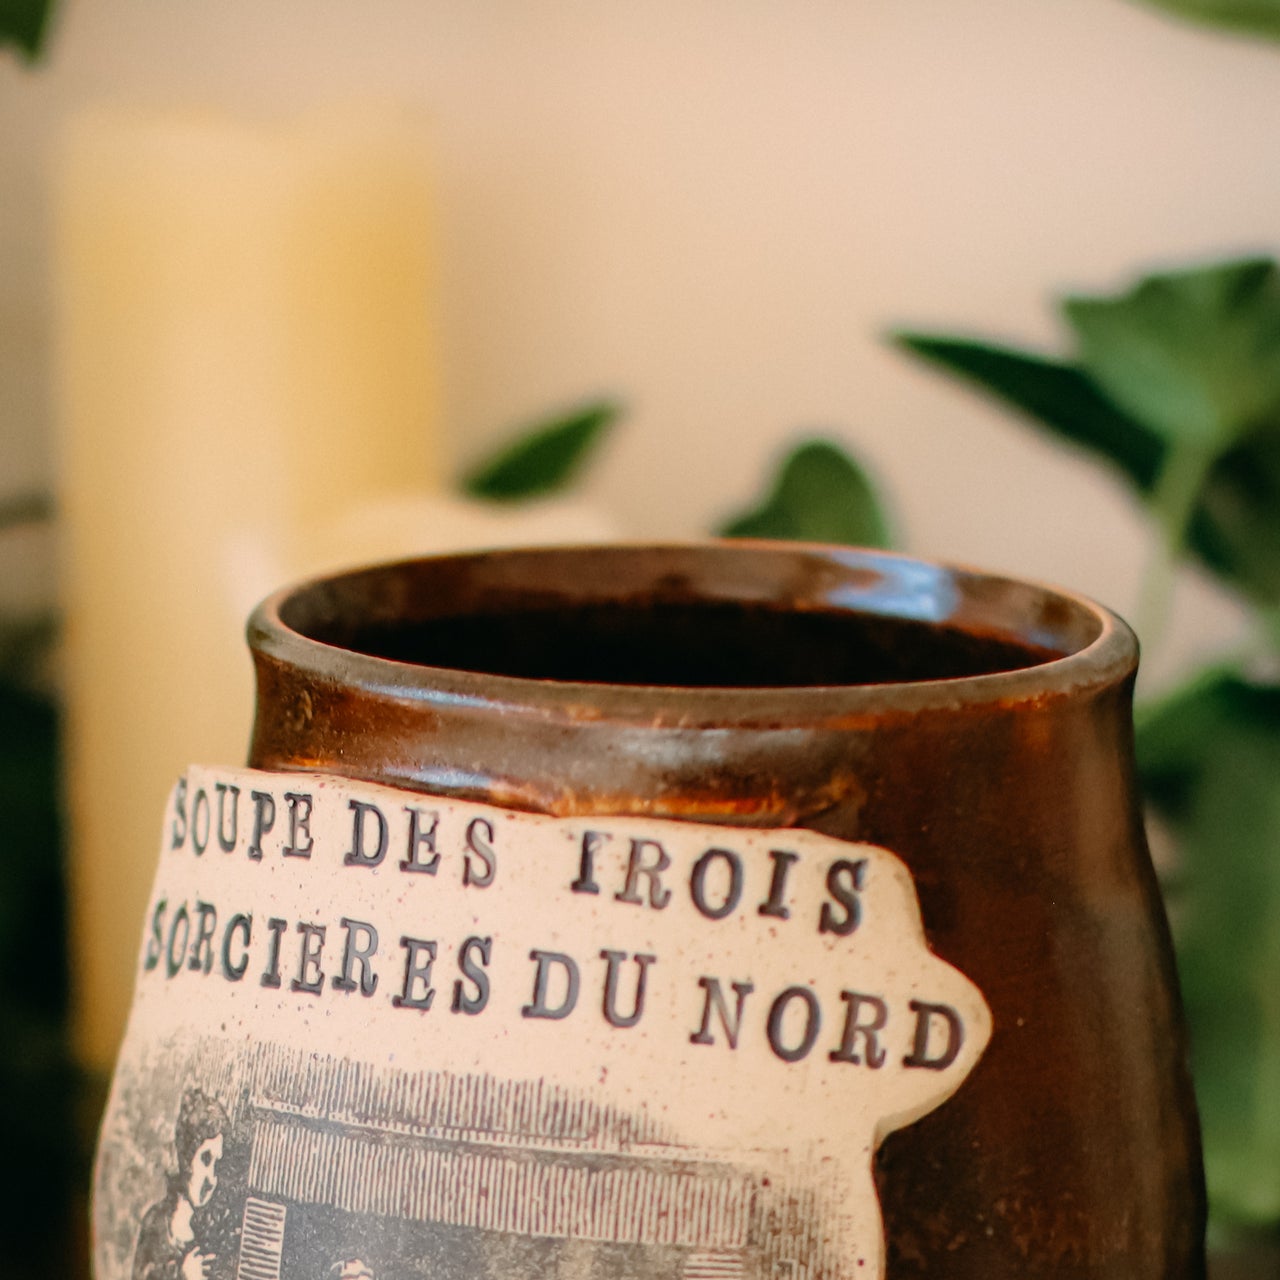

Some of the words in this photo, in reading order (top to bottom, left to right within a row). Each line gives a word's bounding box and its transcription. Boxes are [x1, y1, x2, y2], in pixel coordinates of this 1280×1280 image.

[171, 776, 315, 862] SOUPE
[343, 799, 498, 888] DES
[569, 830, 869, 936] TROIS
[143, 898, 493, 1016] SORCIERES
[521, 948, 657, 1029] DU
[689, 976, 966, 1071] NORD
